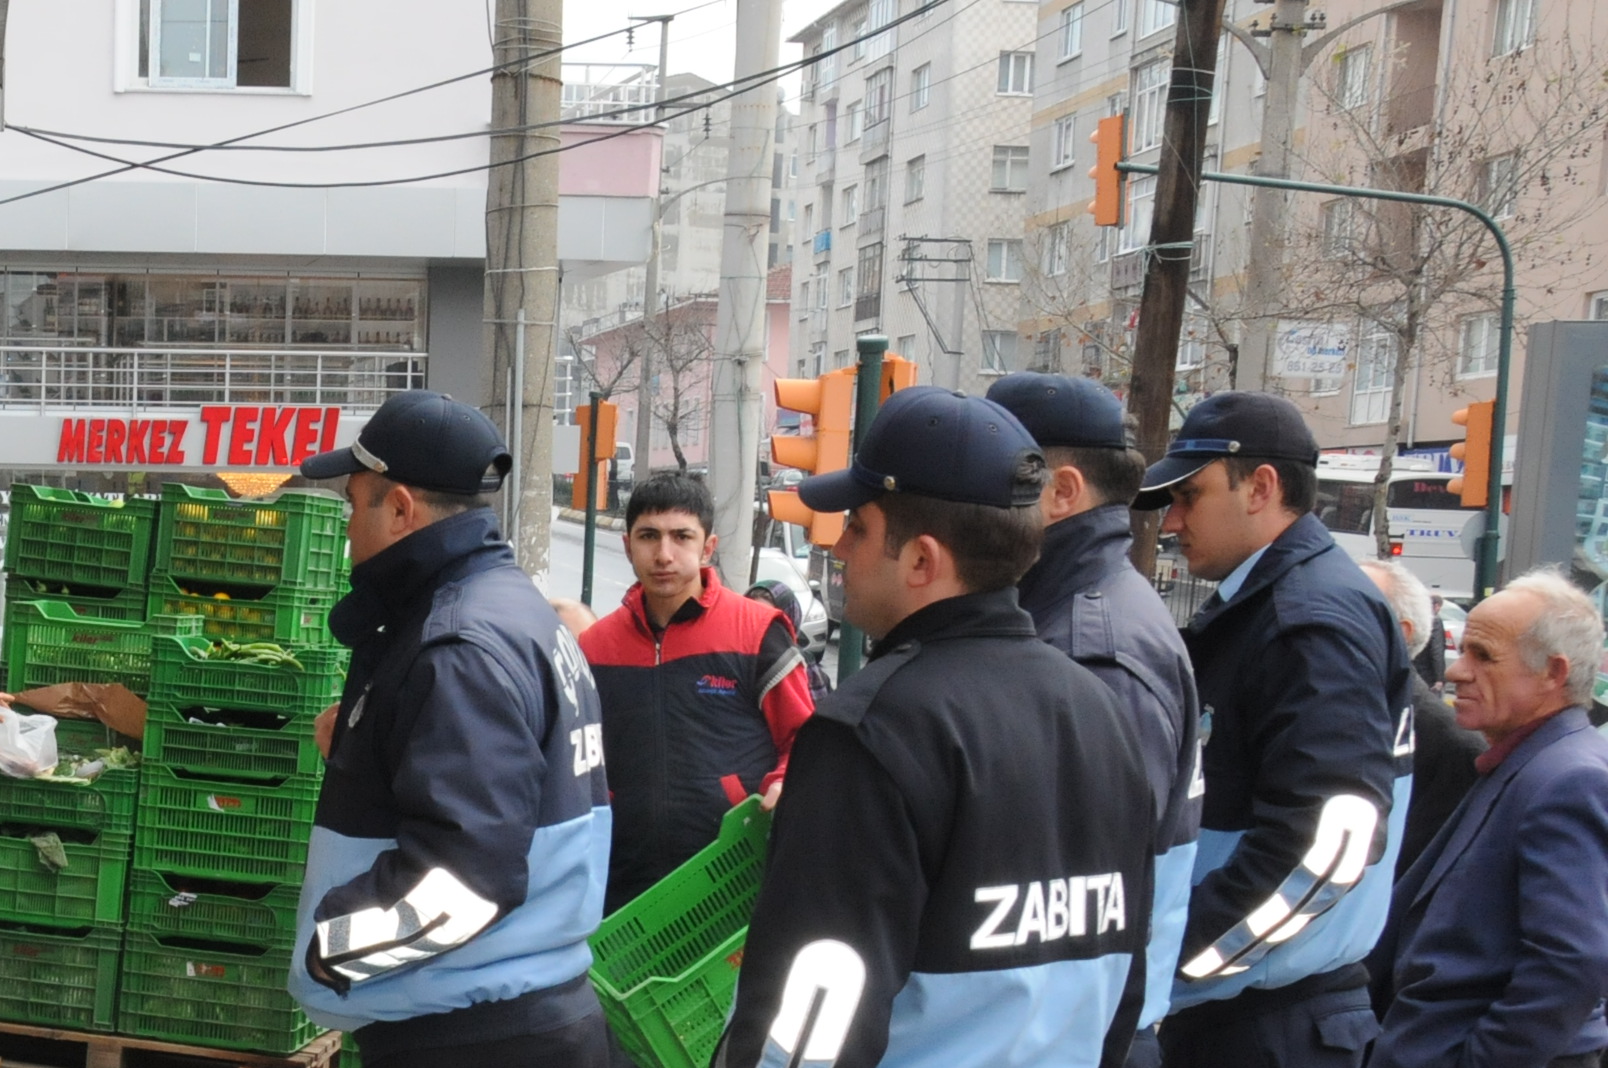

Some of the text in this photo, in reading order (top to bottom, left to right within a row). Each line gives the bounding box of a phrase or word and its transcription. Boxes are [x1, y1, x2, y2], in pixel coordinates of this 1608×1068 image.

[56, 418, 189, 464] MERKEZ
[710, 674, 738, 689] kiler
[969, 872, 1125, 949] ZABITA
